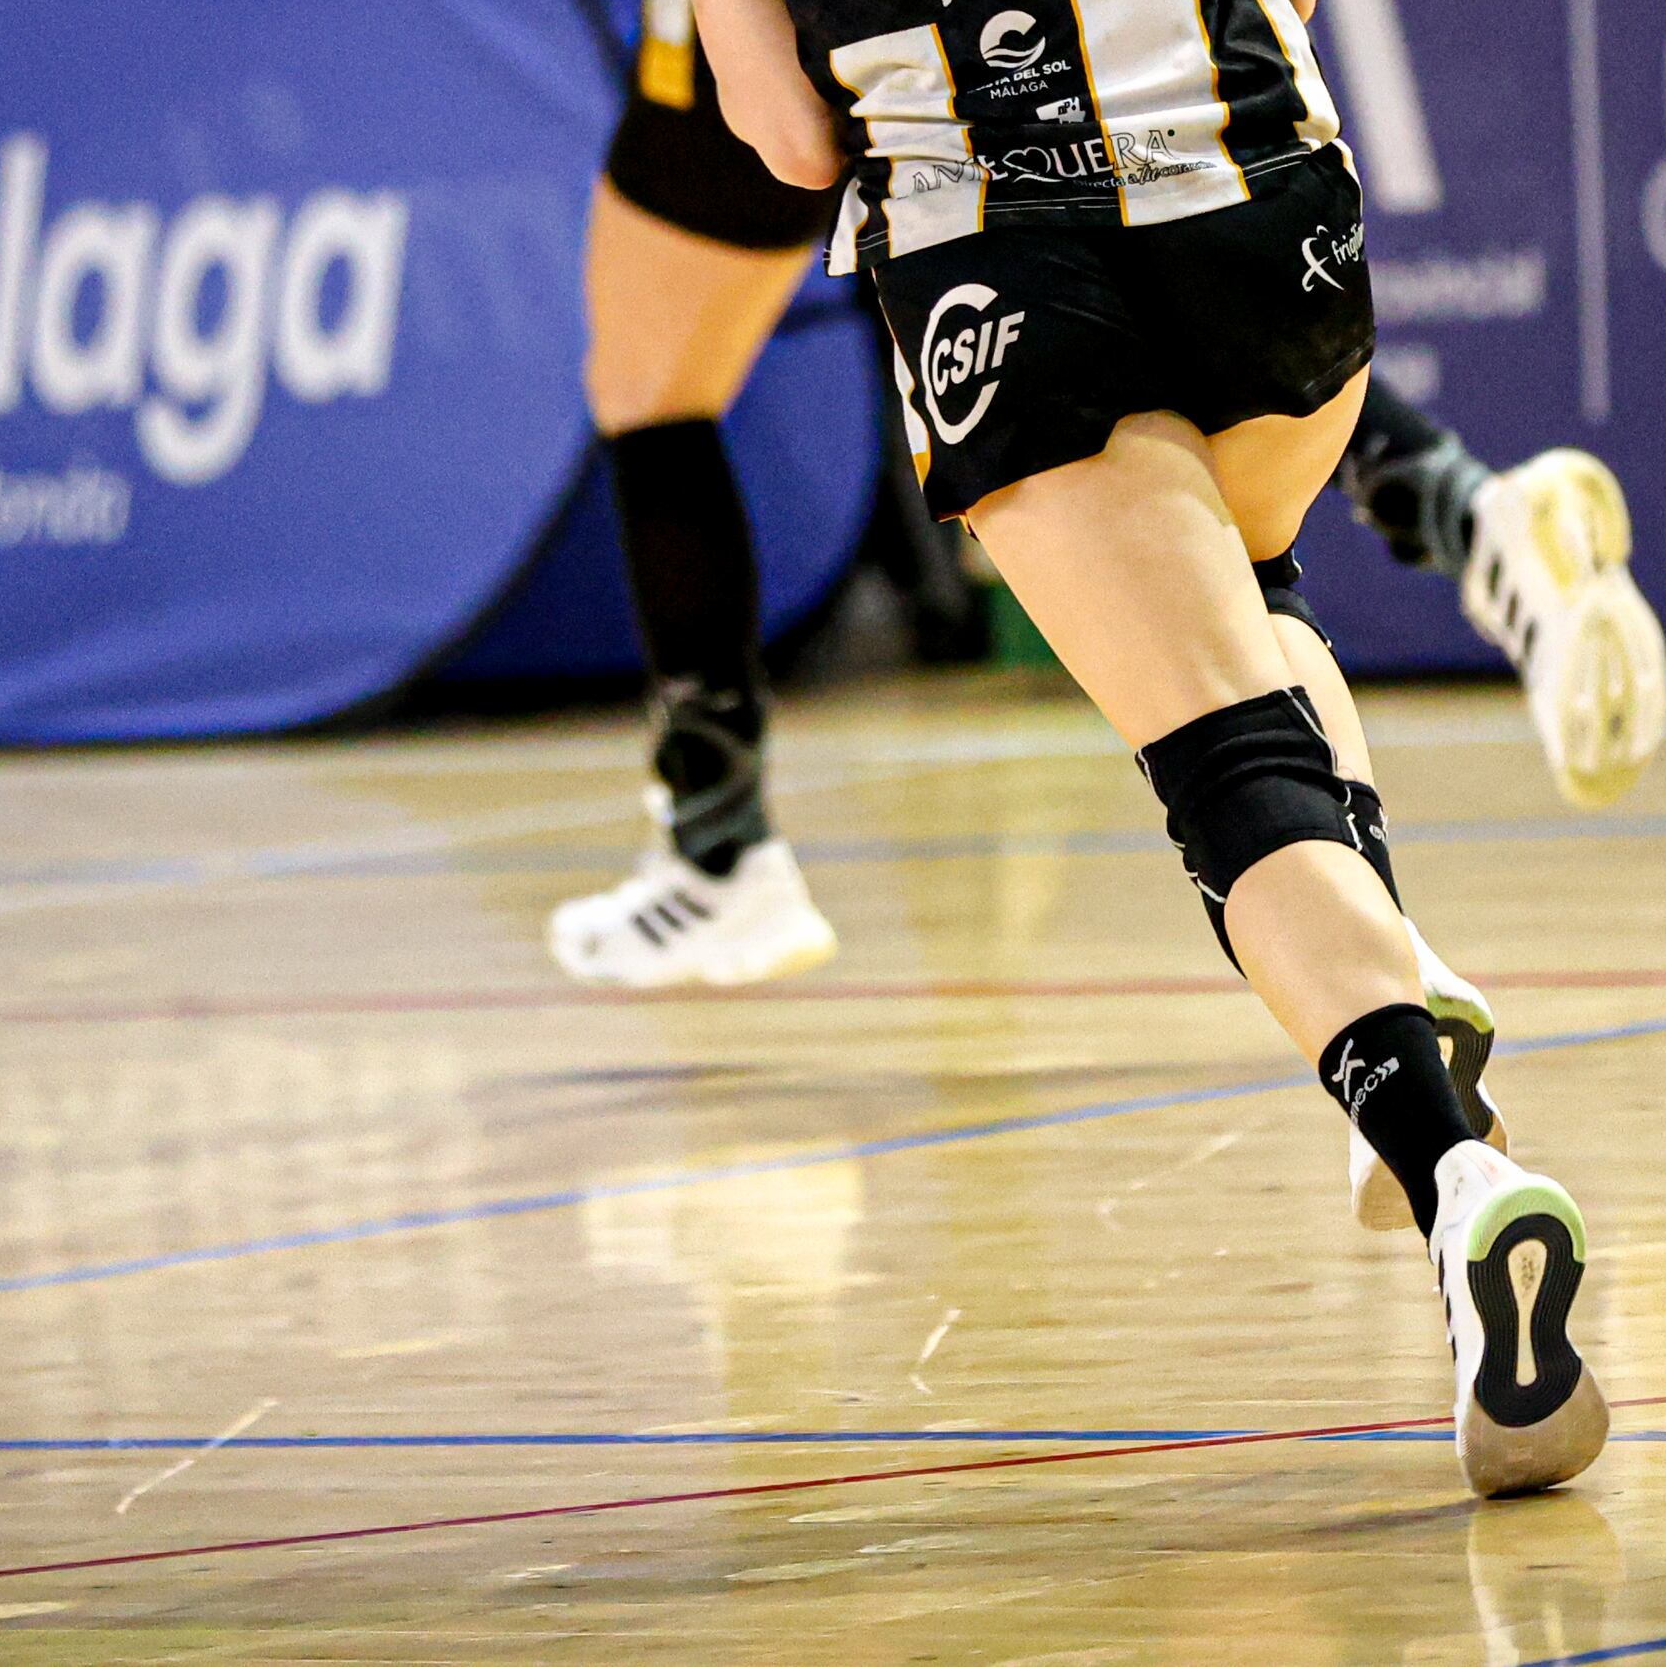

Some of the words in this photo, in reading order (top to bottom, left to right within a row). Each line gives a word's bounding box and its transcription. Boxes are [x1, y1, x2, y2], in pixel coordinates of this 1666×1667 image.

[1013, 67, 1041, 82] DEL
[1041, 59, 1072, 75] SOL
[989, 79, 1050, 100] MÁLAGA
[932, 310, 1025, 397] CSIF
